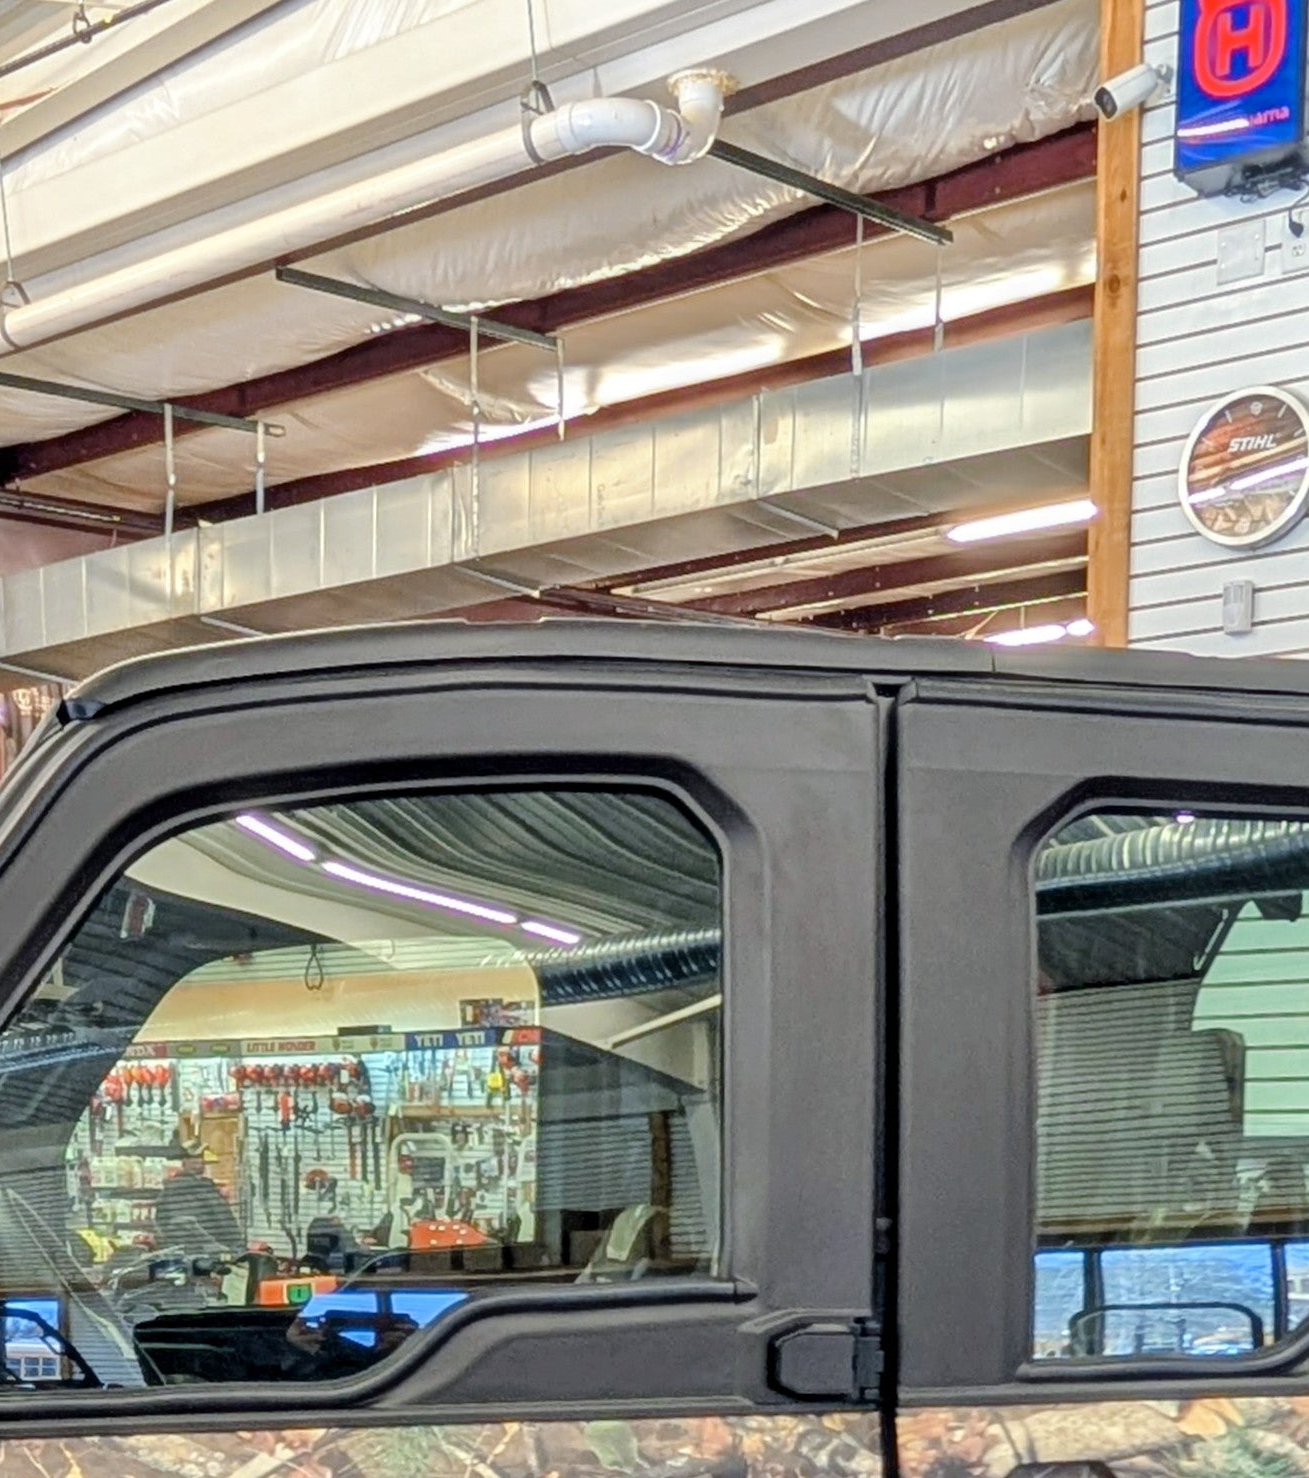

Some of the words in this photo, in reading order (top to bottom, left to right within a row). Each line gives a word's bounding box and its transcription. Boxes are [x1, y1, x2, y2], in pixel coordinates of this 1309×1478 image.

[1227, 434, 1277, 453] STIHL
[247, 1041, 277, 1053] LITTLE
[414, 1034, 444, 1047] YETI
[456, 1031, 486, 1045] YETI
